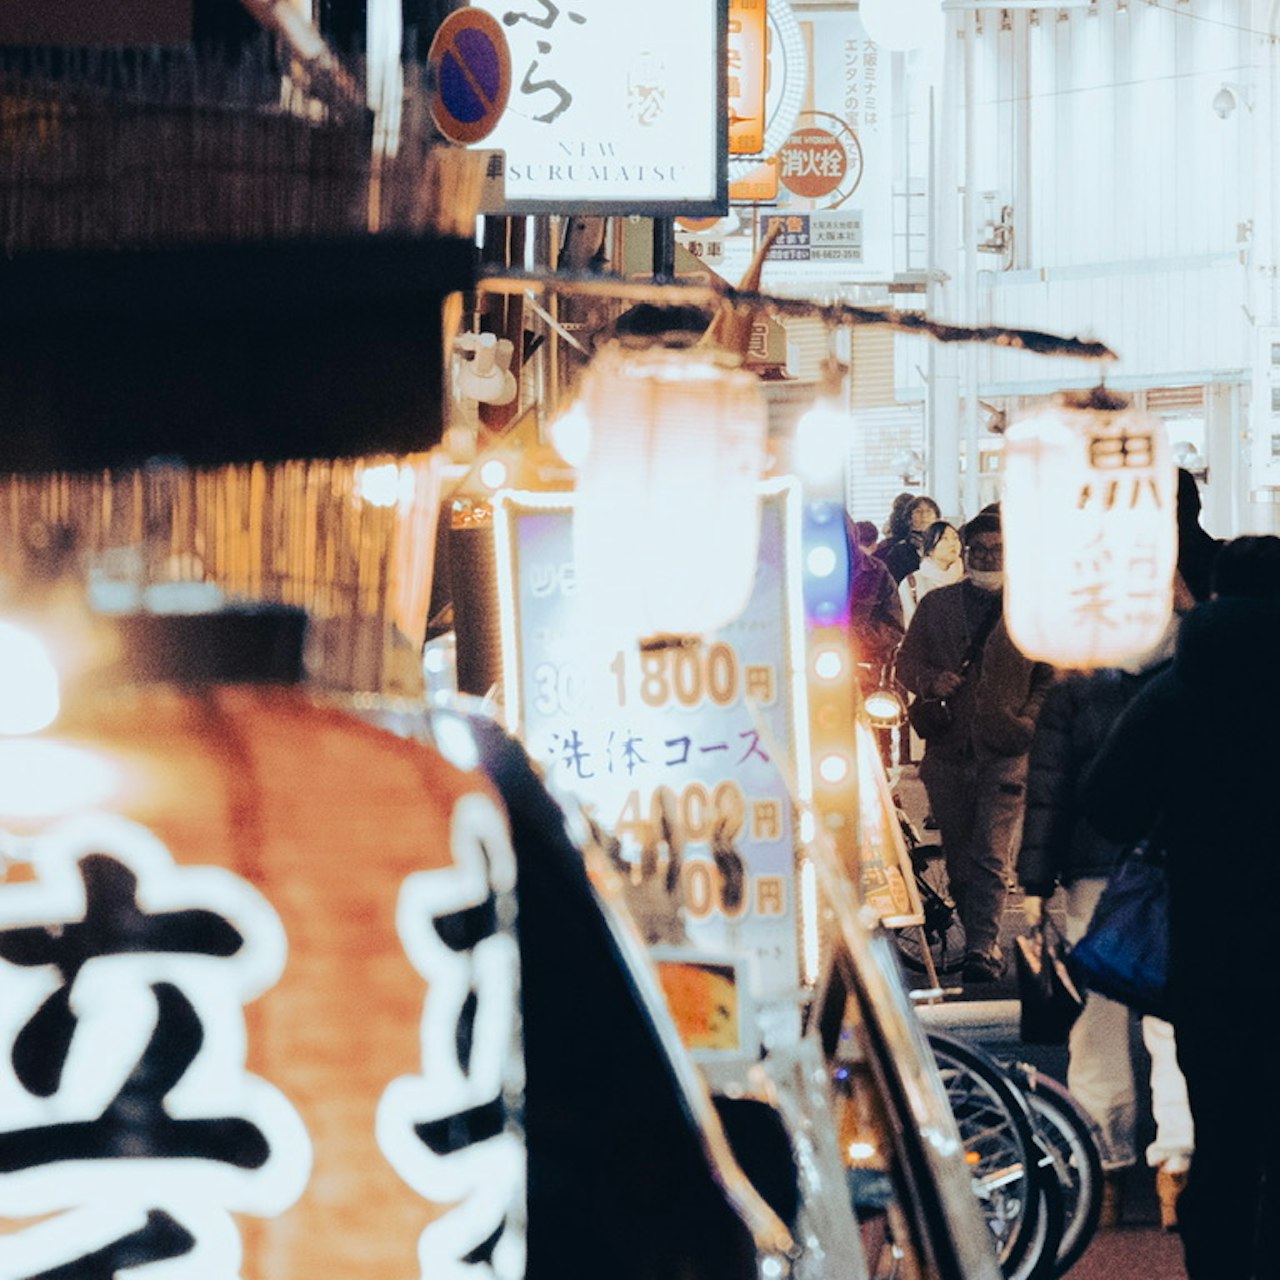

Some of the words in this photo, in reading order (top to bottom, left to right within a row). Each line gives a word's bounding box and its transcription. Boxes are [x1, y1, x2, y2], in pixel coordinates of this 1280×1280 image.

[558, 141, 617, 157] NEW
[781, 148, 843, 178] 消火栓
[549, 729, 771, 780] 洗体コース
